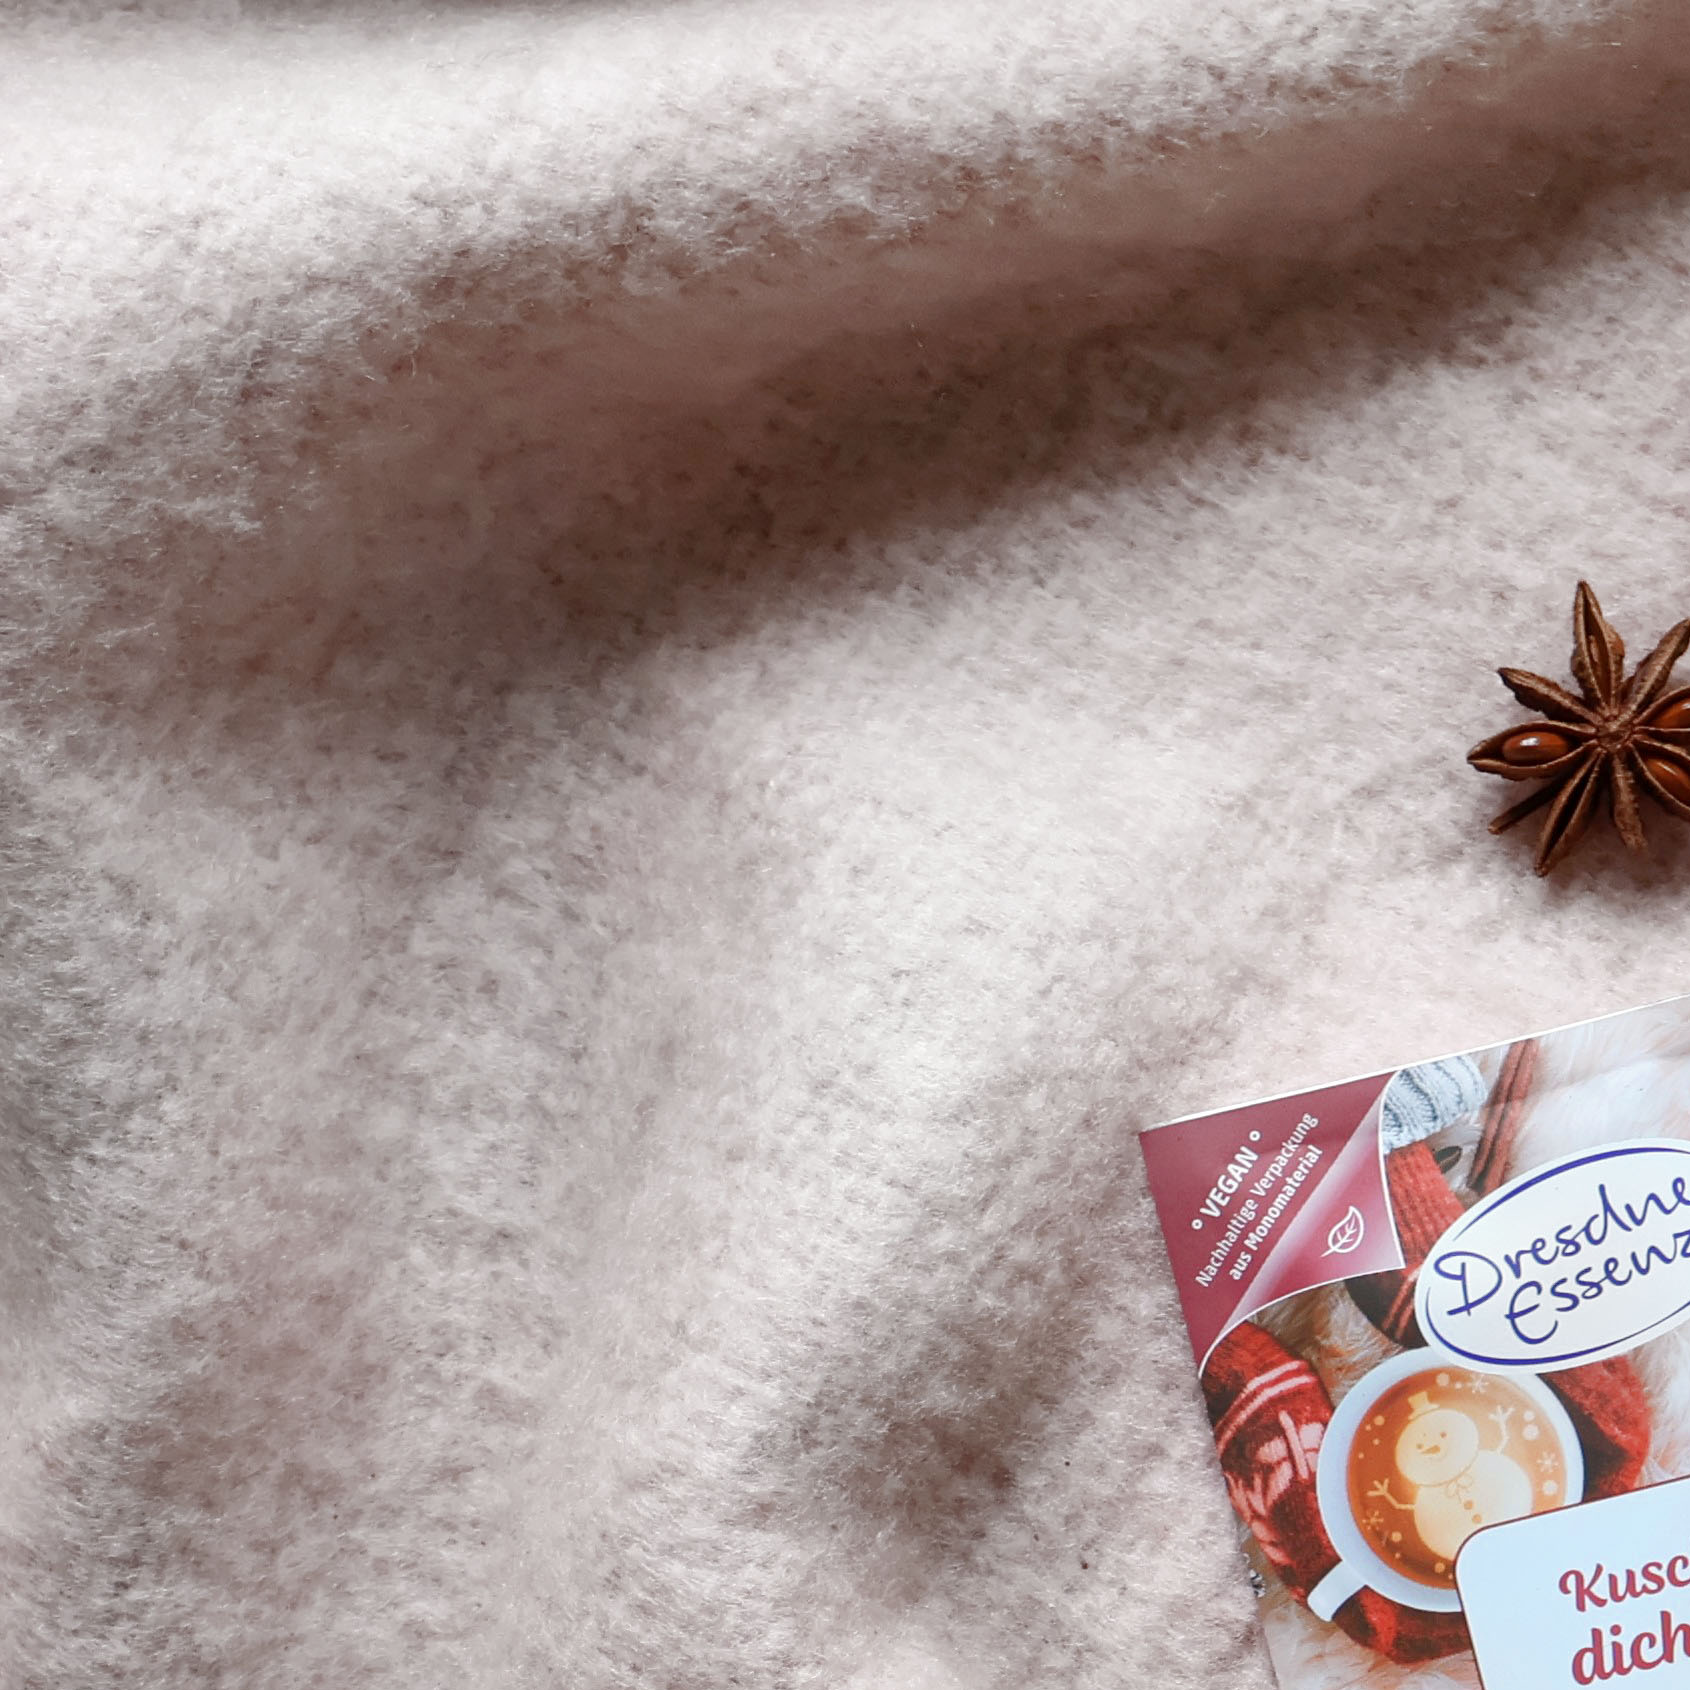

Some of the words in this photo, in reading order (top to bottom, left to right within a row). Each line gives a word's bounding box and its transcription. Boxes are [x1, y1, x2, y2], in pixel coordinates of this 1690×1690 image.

[1195, 1199, 1258, 1288] Nachhaltige
[1250, 1112, 1319, 1197] Verpackung
[1200, 1146, 1259, 1218] VEGAN
[1229, 1251, 1251, 1281] aus
[1244, 1144, 1323, 1251] Monomaterial
